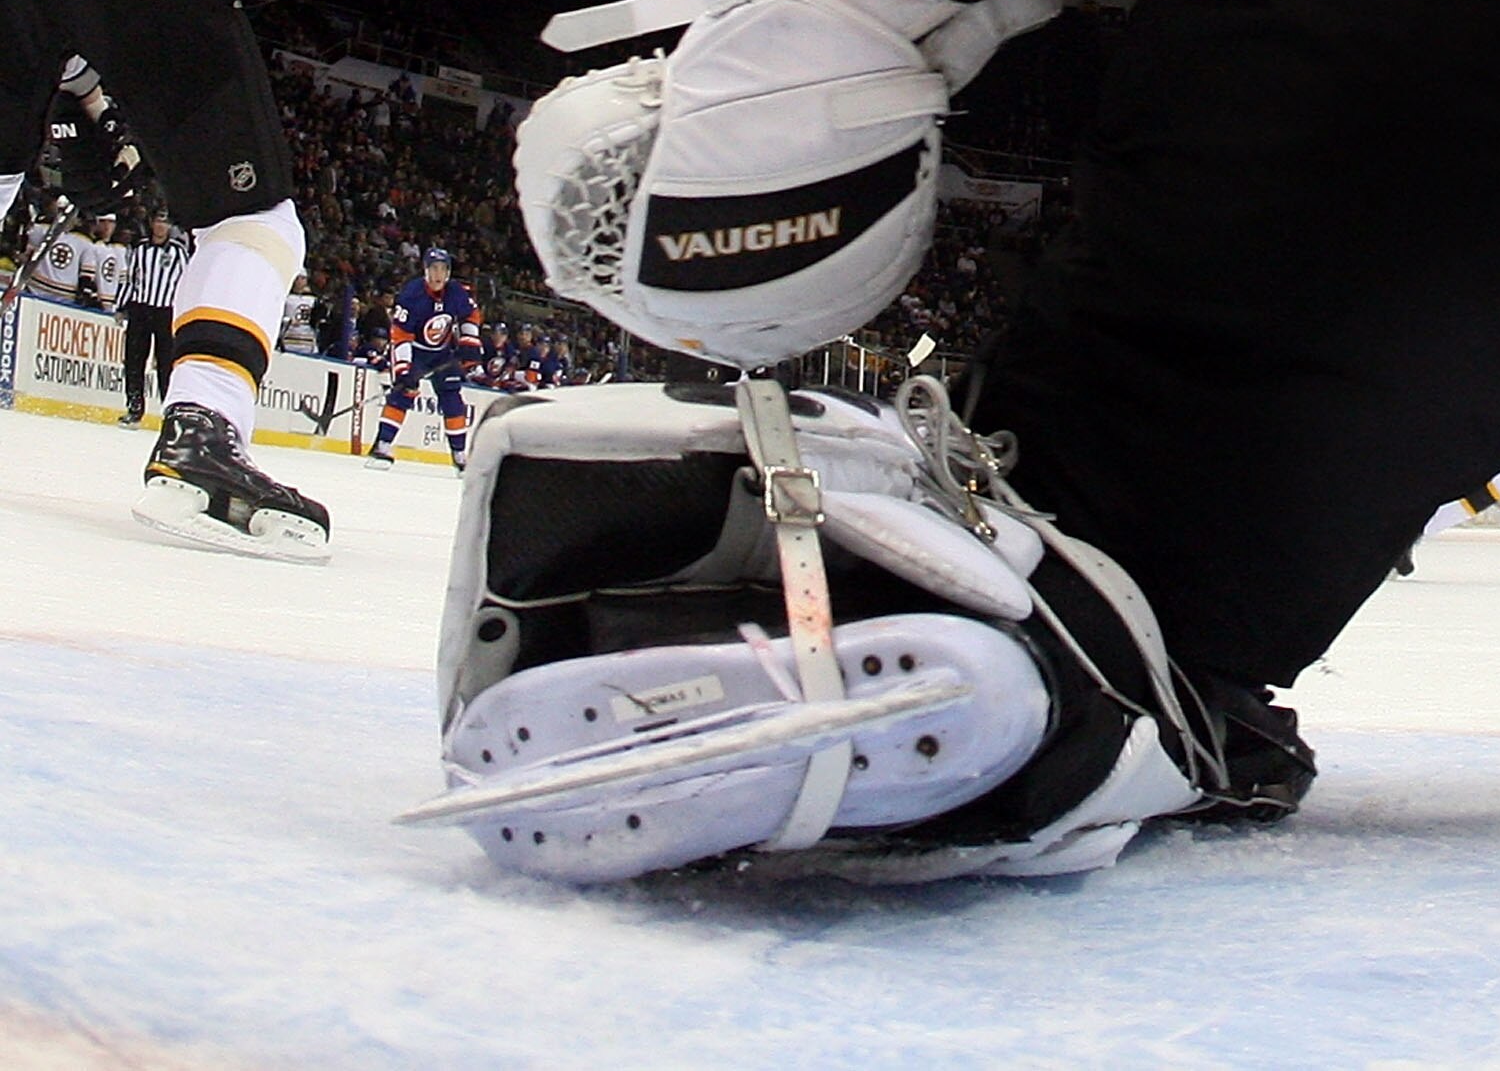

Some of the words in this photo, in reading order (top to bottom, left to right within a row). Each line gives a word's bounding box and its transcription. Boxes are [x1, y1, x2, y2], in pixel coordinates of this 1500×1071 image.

[657, 206, 844, 262] VAUGHN
[37, 312, 101, 359] HOCKEY
[34, 353, 95, 388] SATURDAY
[96, 364, 124, 393] NIGH
